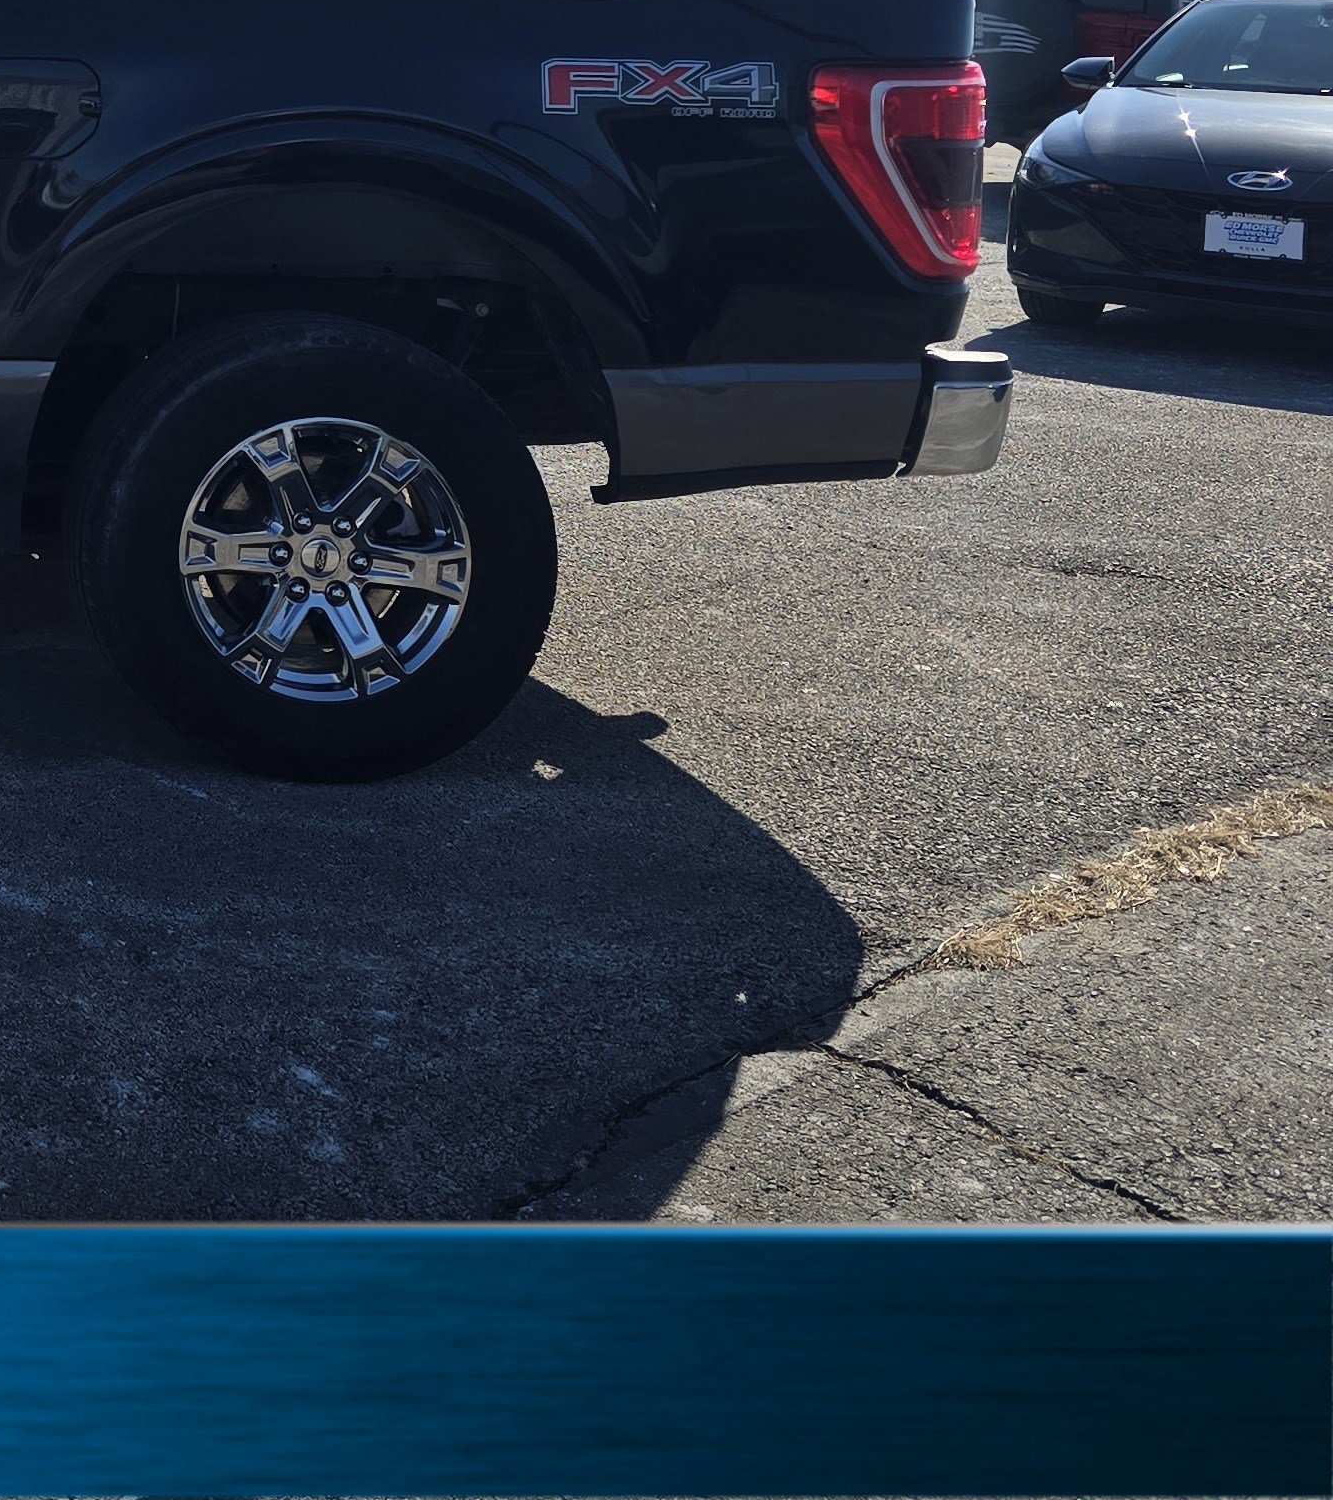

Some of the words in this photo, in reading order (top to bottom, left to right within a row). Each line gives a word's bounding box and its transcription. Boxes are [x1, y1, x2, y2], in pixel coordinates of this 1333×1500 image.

[541, 57, 780, 116] FX4
[671, 107, 714, 117] OFF
[719, 107, 777, 119] ROAD
[1224, 221, 1241, 229] ED
[1241, 222, 1285, 234] MORSE
[1228, 228, 1281, 238] CHEVROLET
[1239, 245, 1266, 253] ROLLA
